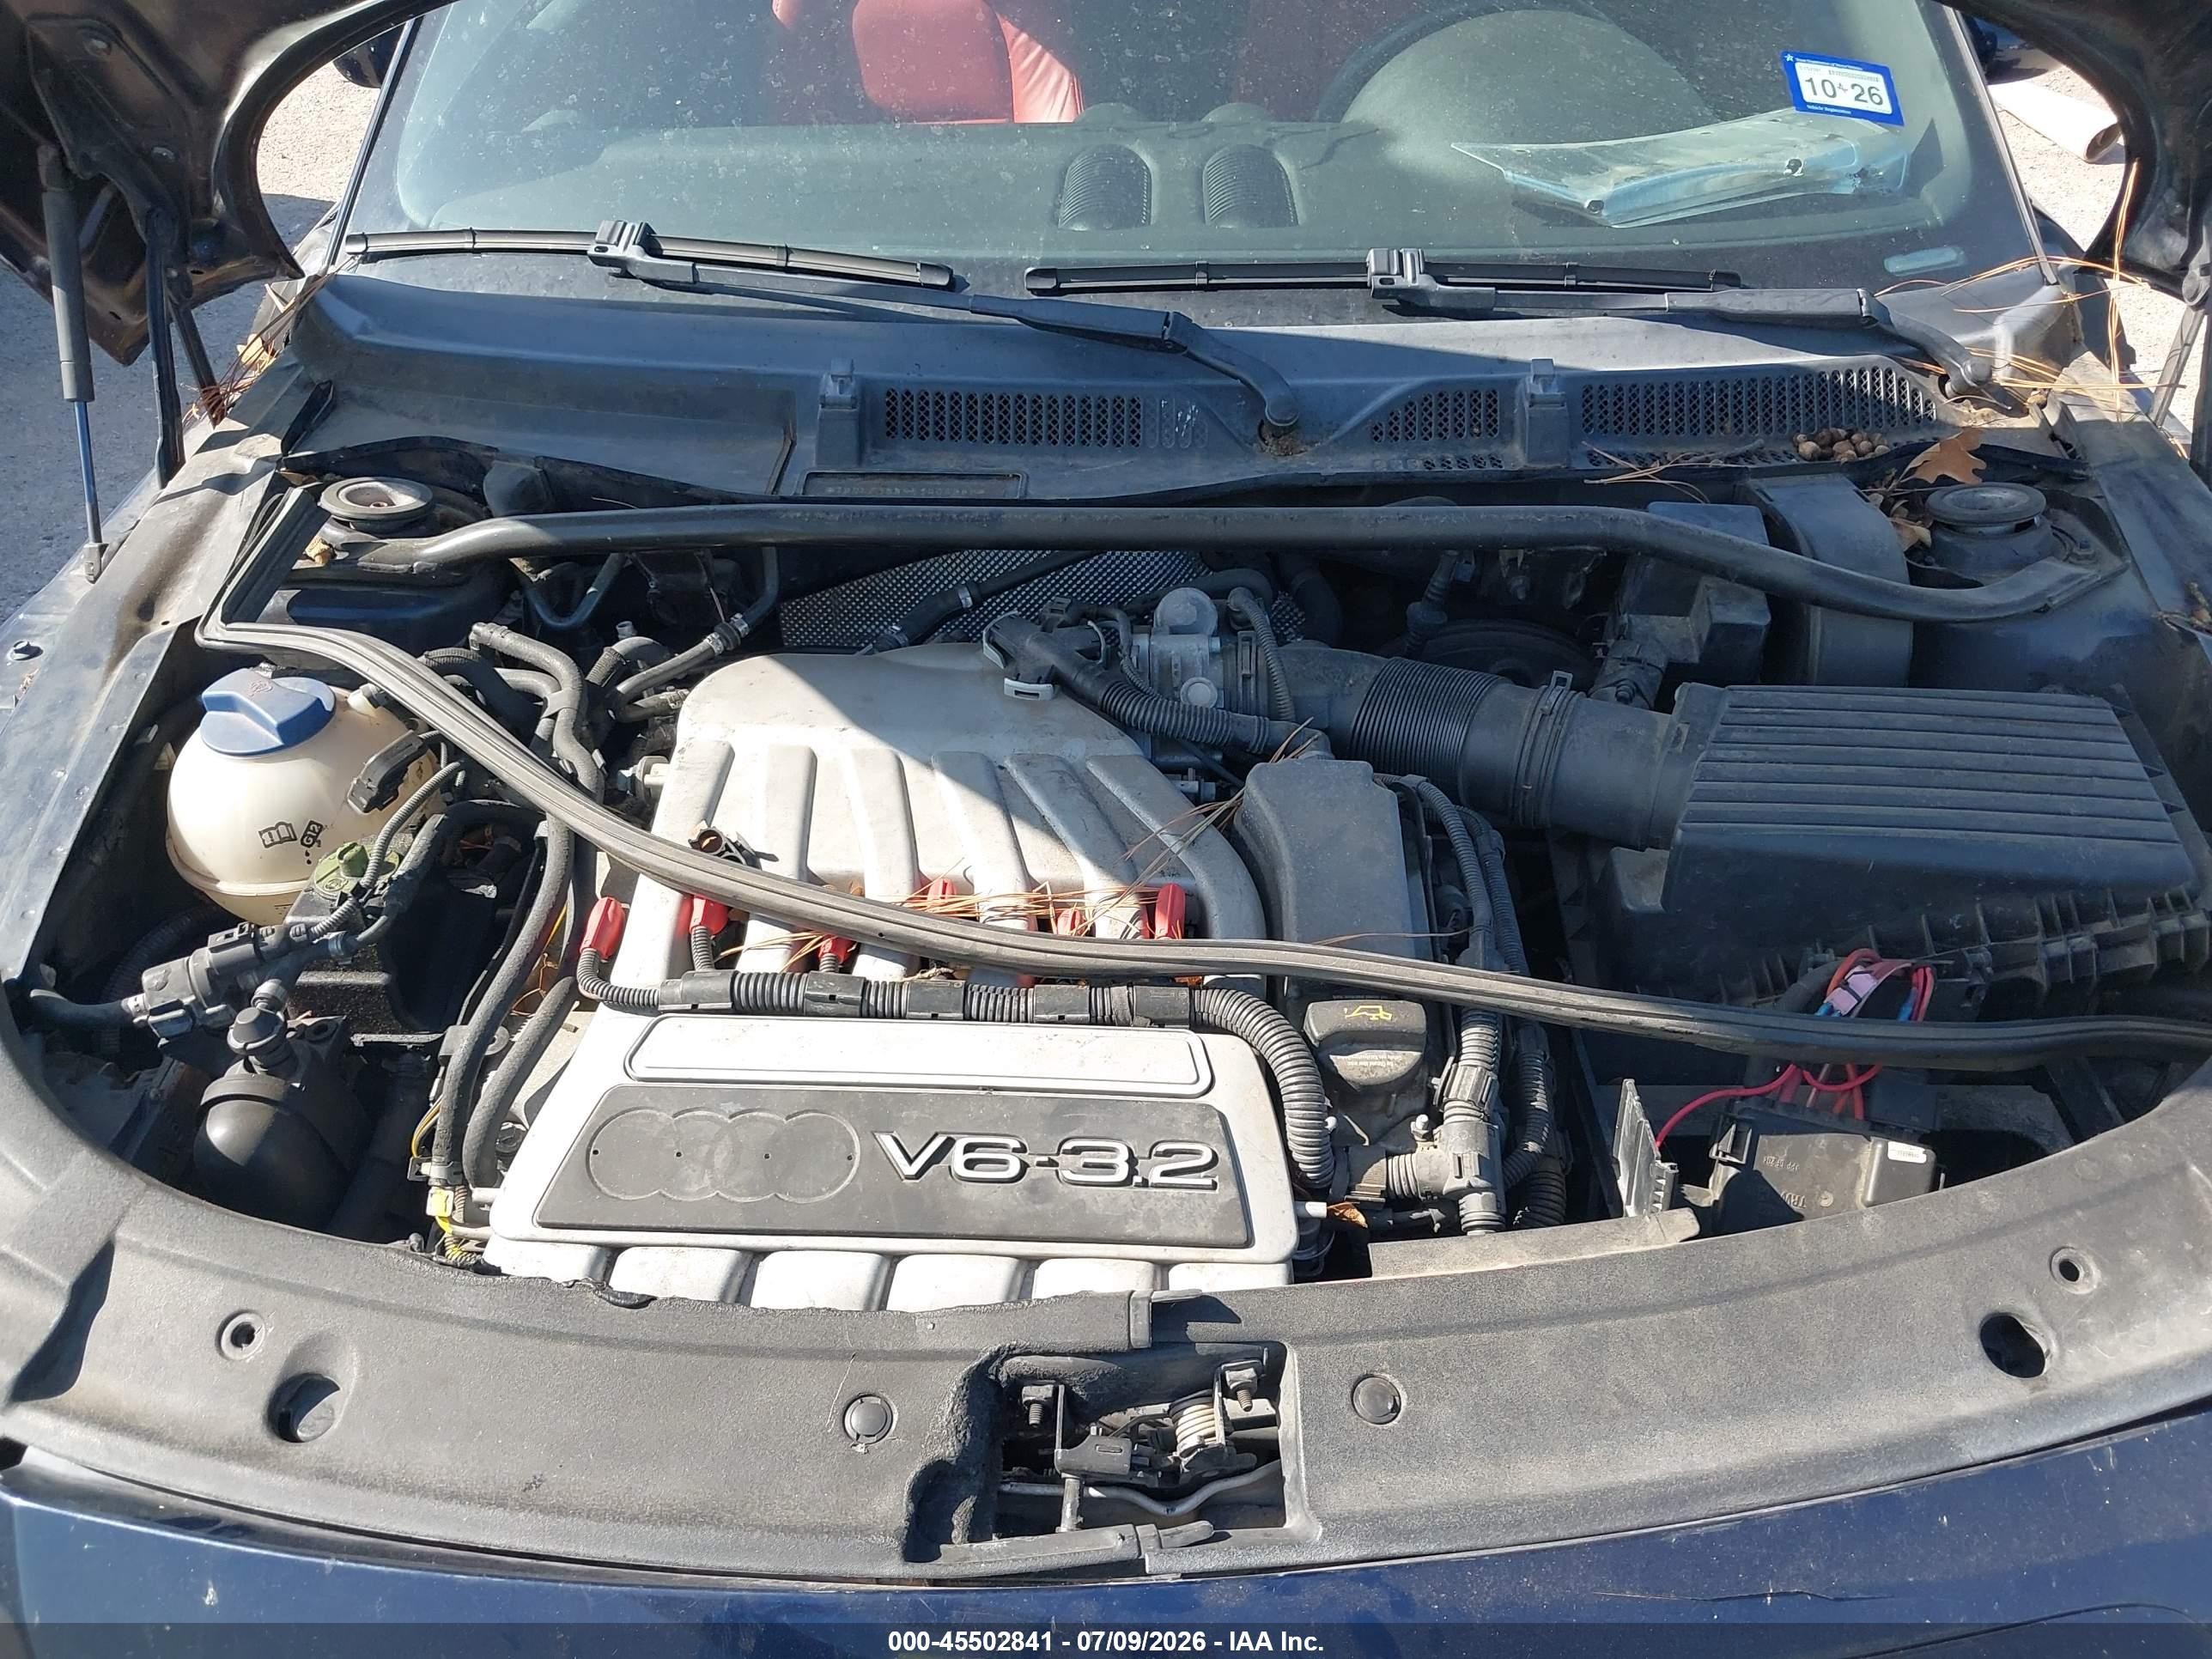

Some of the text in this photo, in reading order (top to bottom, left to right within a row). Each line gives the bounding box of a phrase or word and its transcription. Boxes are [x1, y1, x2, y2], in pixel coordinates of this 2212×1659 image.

[1805, 77, 1883, 106] 10 26
[303, 823, 321, 845] G12
[872, 1132, 1218, 1190] V6-3.2
